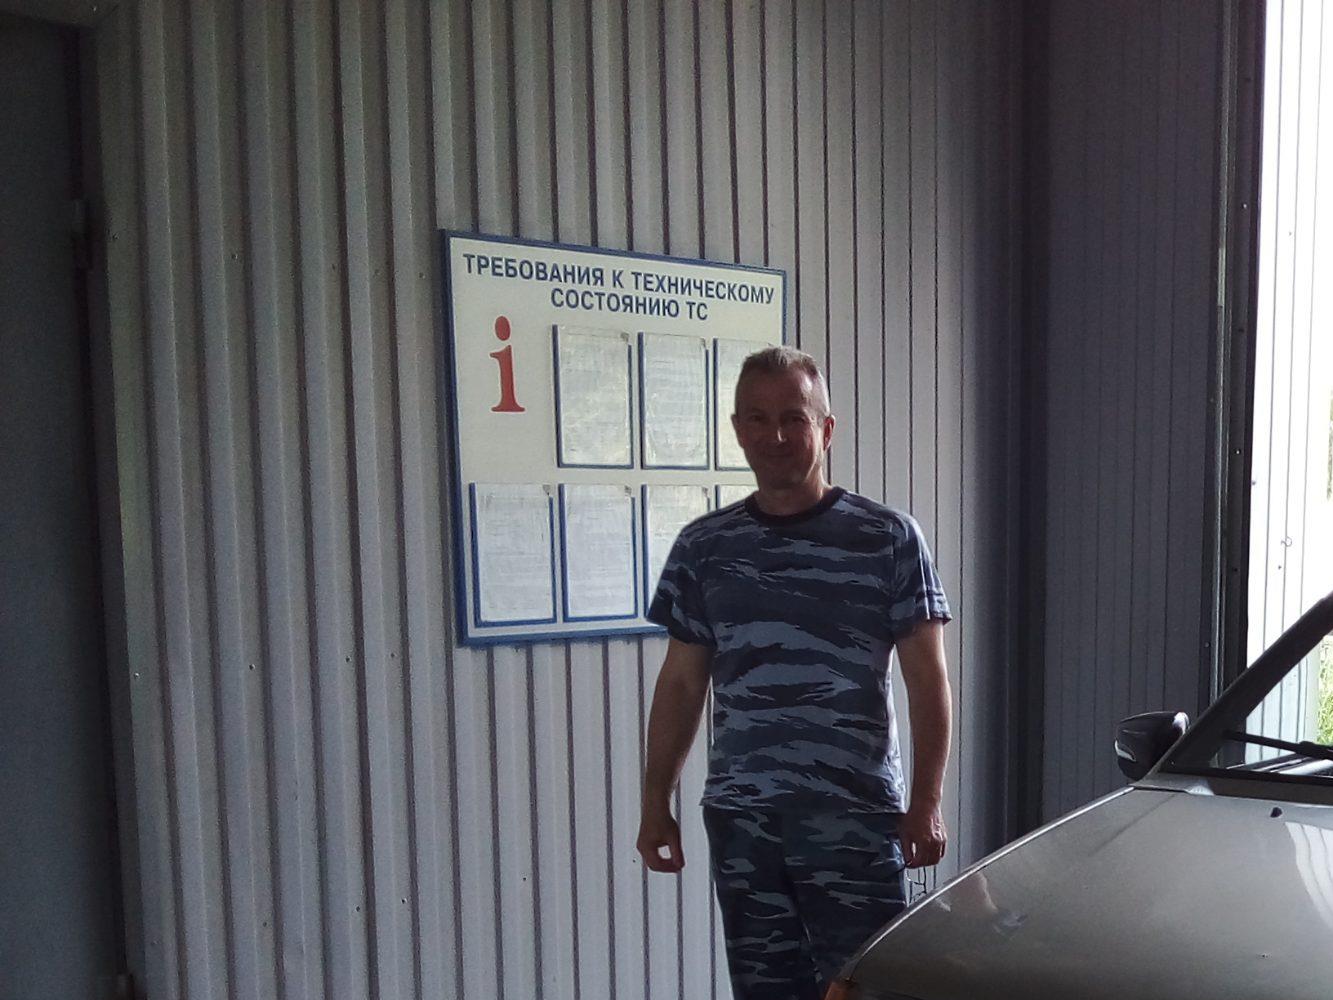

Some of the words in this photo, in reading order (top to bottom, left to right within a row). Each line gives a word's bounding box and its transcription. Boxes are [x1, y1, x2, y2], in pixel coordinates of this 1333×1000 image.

[462, 252, 604, 288] ТРЕБОВАНИЯ
[611, 270, 625, 289] К
[631, 271, 775, 305] ТЕХНИЧЕСКОМУ
[550, 287, 680, 319] СОСТОЯНИЮ
[686, 300, 708, 321] ТС
